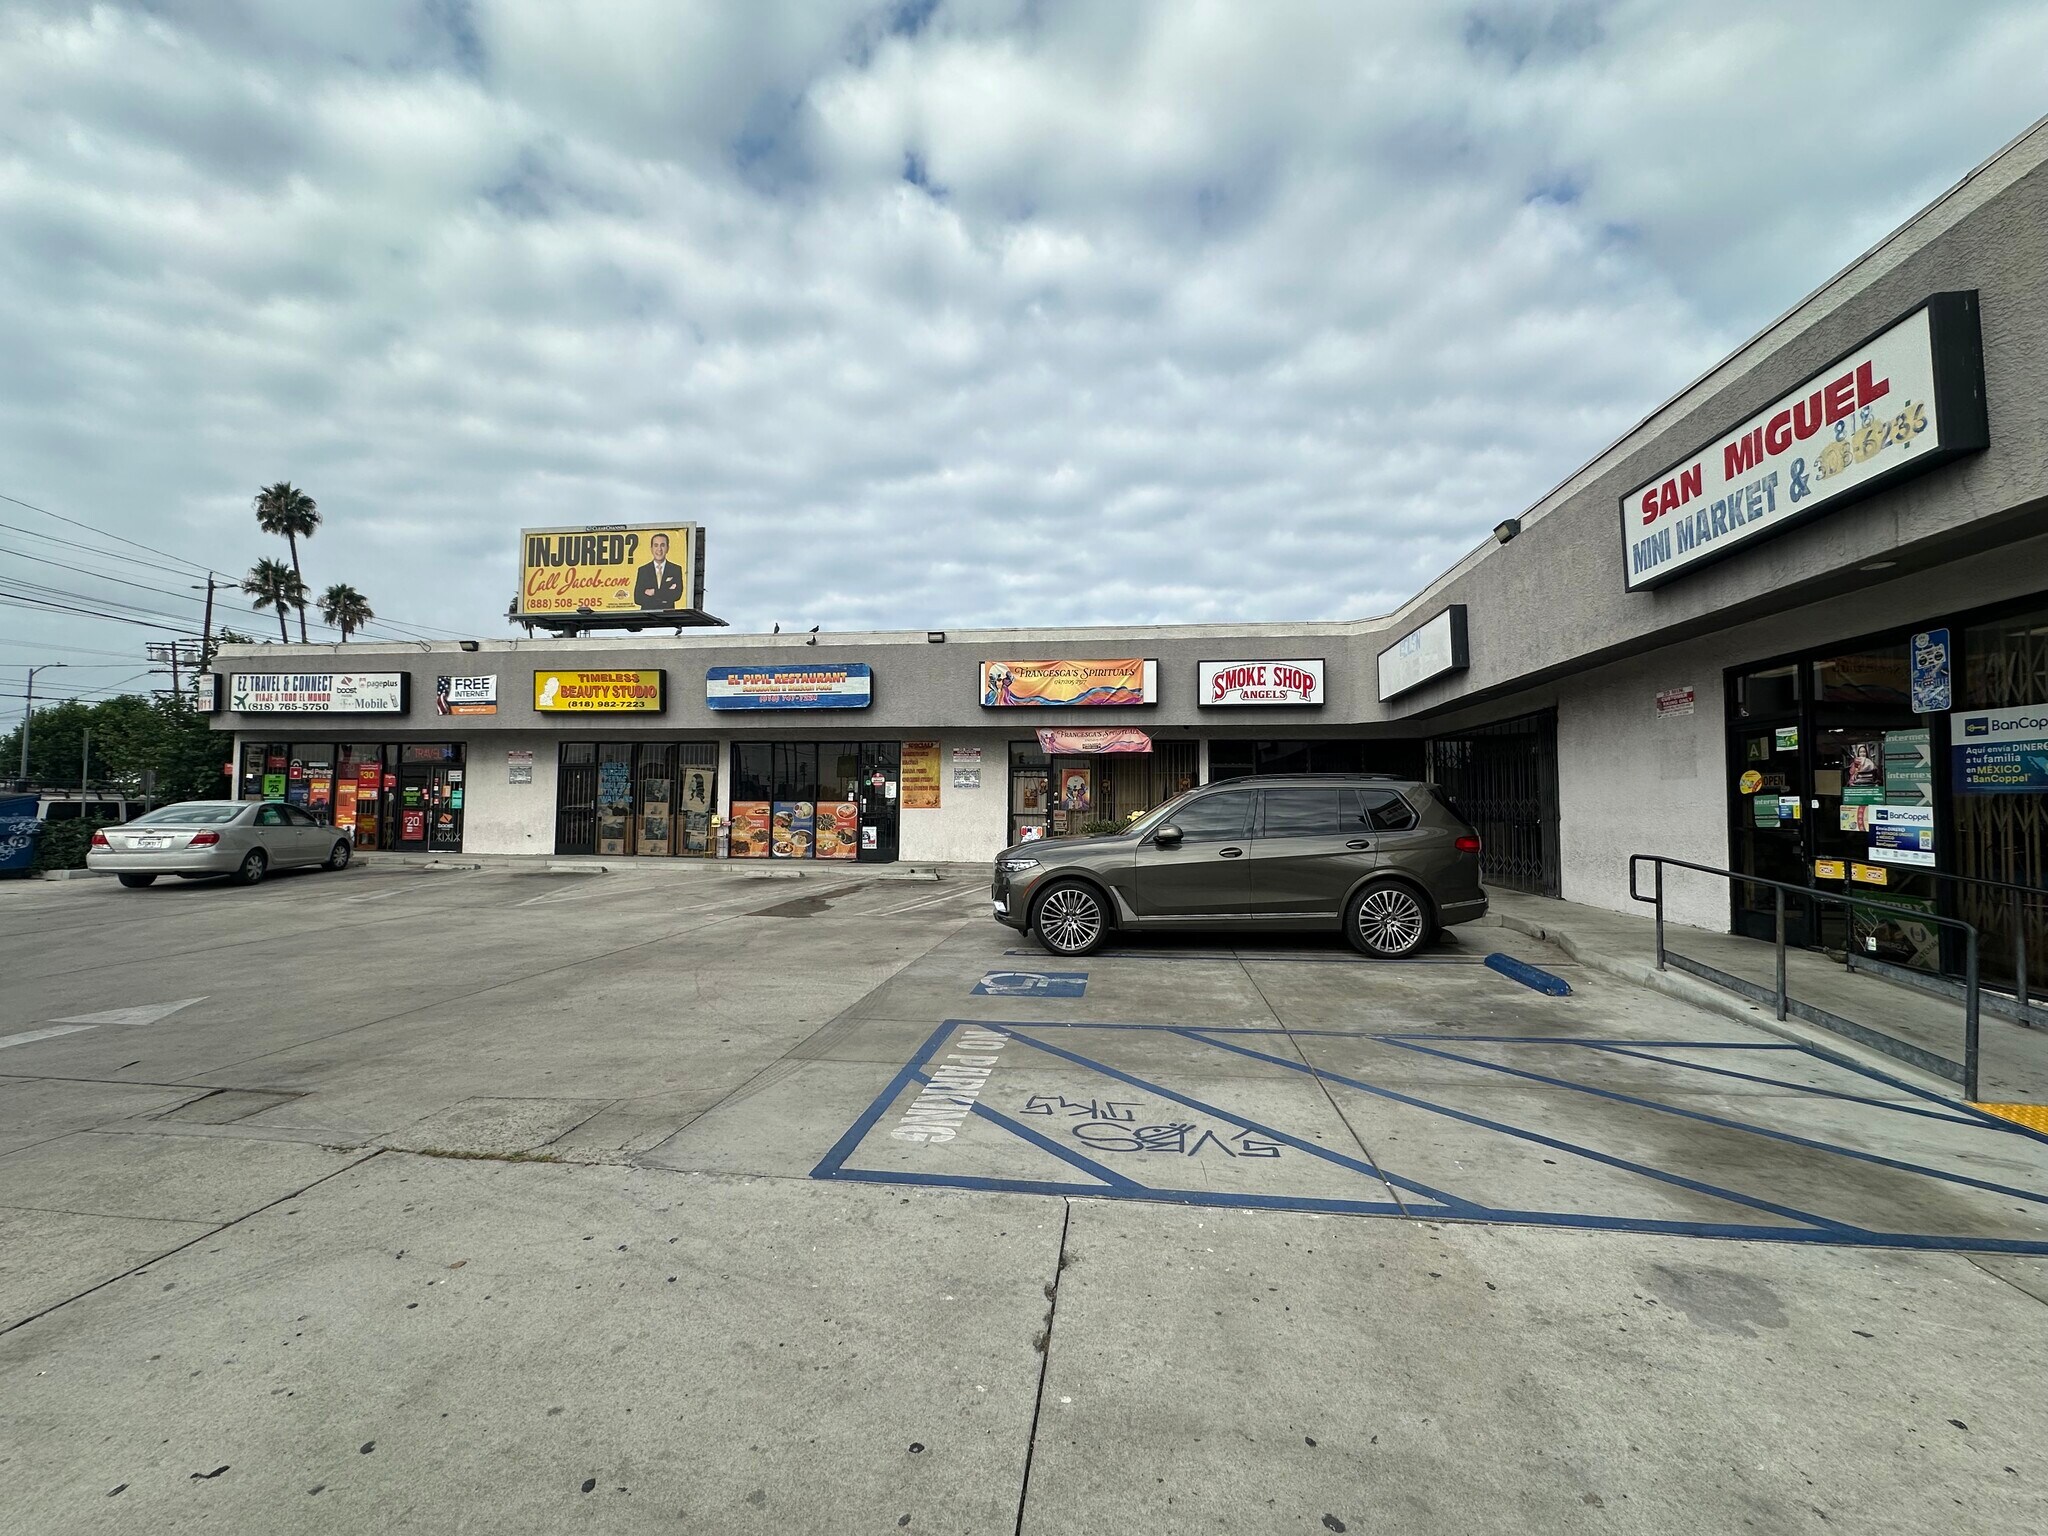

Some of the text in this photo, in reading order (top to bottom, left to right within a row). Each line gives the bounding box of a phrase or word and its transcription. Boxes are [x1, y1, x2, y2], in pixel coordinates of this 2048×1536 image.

[1641, 360, 1890, 525] SAN MIGUEL
[1632, 457, 1812, 575] MINI MARKET &
[528, 533, 639, 567] INJURED?
[527, 567, 631, 596] Call Jacob.com
[526, 598, 552, 610] (888)
[554, 597, 603, 608] 508-5085
[577, 673, 640, 683] TIMELESS
[727, 672, 848, 685] EL PIPIL RESTAURANT
[1080, 668, 1136, 680] SPIRITUALS
[237, 676, 333, 692] EZ TRAVEL & CONNECT
[455, 678, 490, 690] FREE
[1213, 666, 1314, 700] SMOKE SHOP
[255, 693, 273, 702] VIAJE
[299, 693, 306, 702] EL
[560, 685, 658, 699] BEAUTY STUDIO
[1242, 690, 1286, 699] ANGELS
[248, 702, 329, 711] (818) 765-5750
[1991, 717, 2048, 732] BanCop
[415, 748, 443, 758] TRAVEL
[1749, 744, 1759, 757] A
[1966, 746, 1986, 755] Aquí
[1987, 744, 2011, 753] envía
[1983, 753, 2021, 763] familia
[360, 771, 375, 779] $30
[1977, 764, 2022, 774] MÉXICO
[1763, 775, 1784, 786] OPEN
[1973, 774, 2028, 784] BanCoppel
[404, 816, 420, 826] $20
[1889, 812, 1931, 822] BanCoppel
[890, 1030, 1011, 1143] NO PARKING
